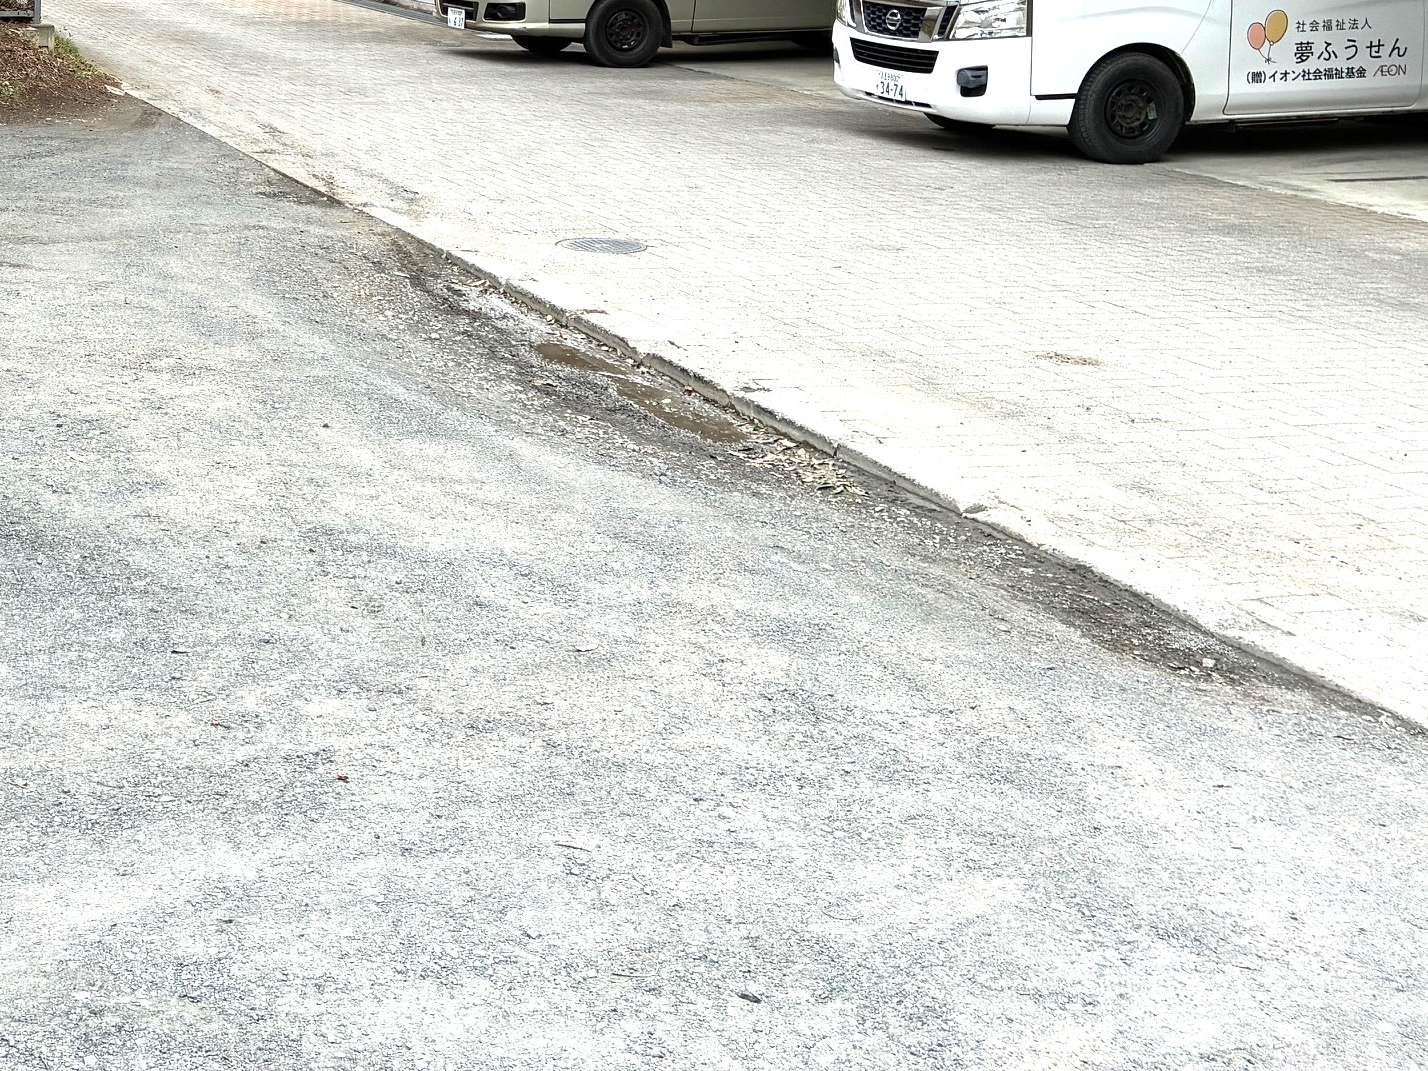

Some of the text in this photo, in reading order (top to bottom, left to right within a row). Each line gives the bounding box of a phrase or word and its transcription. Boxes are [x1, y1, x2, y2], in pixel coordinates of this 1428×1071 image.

[1295, 17, 1372, 33] 社会福祉法人
[1294, 37, 1408, 64] 夢ふうせん
